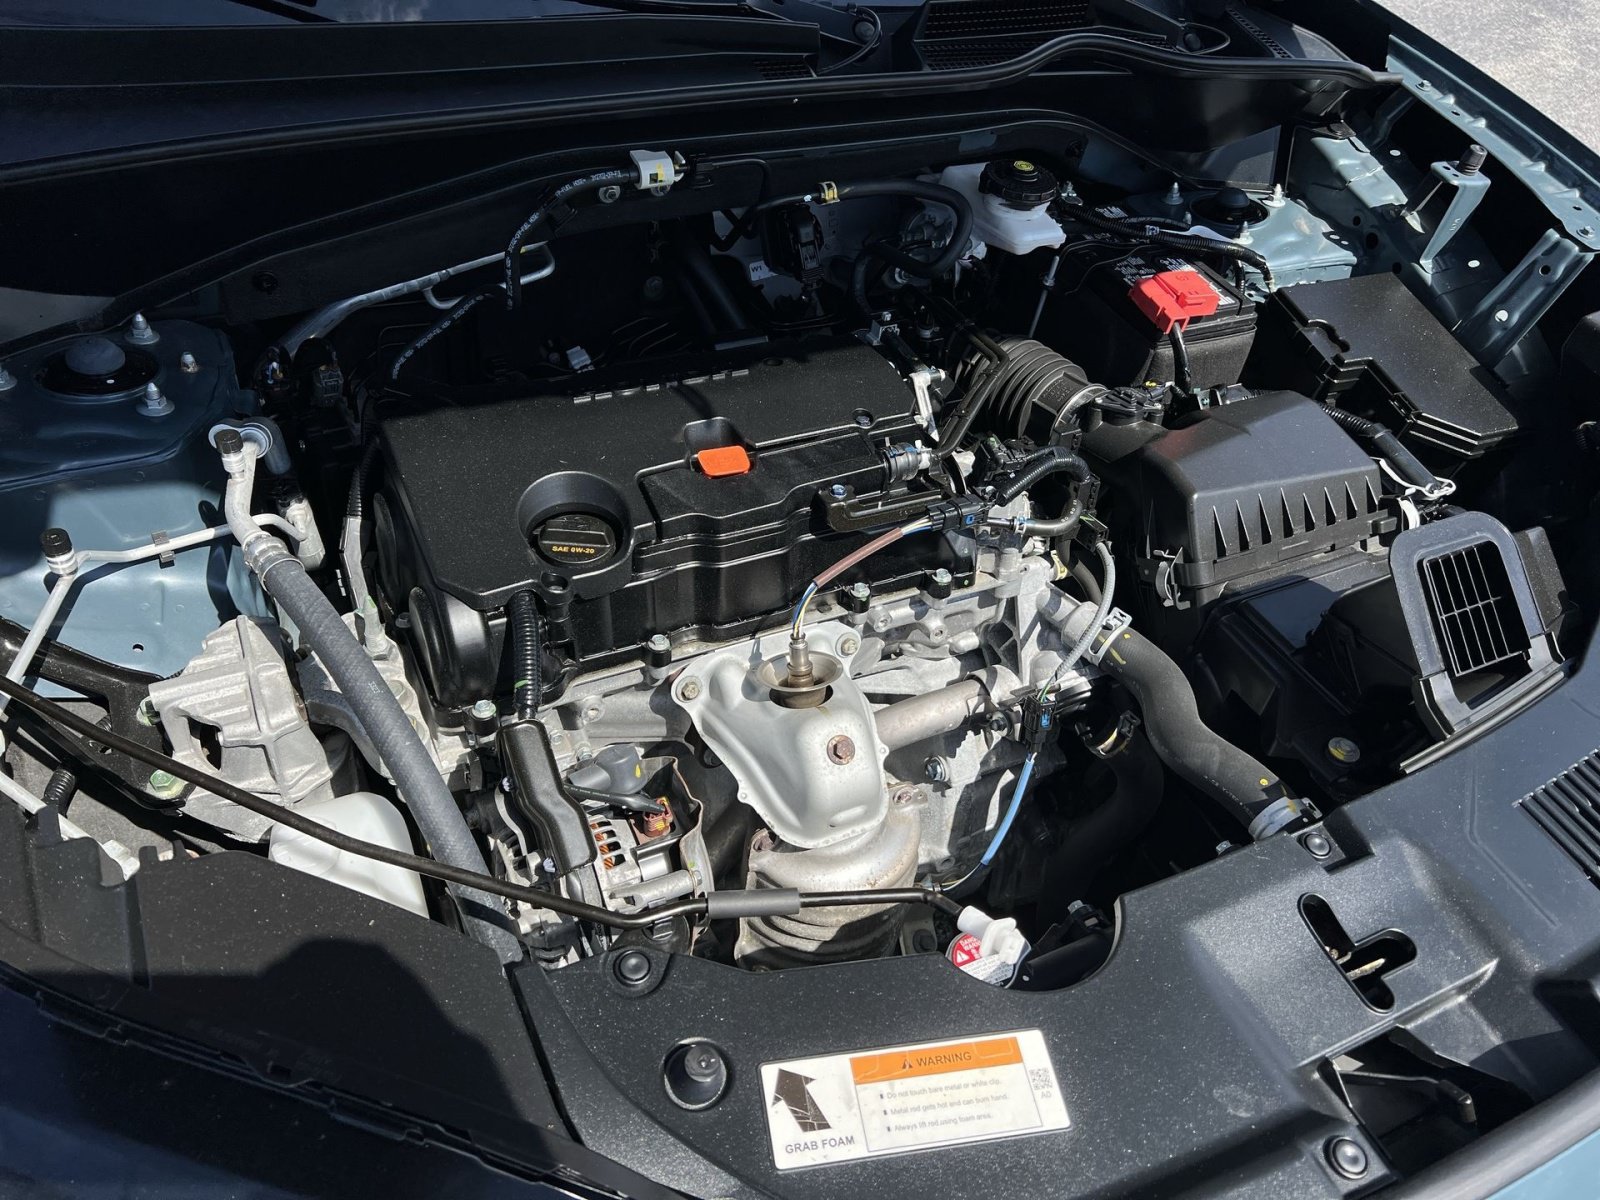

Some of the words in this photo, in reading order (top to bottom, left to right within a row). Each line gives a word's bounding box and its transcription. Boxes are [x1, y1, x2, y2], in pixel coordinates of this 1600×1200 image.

[916, 1051, 972, 1067] WARNING
[909, 1088, 927, 1096] touch
[928, 1086, 943, 1094] bare
[944, 1083, 962, 1091] metal
[890, 1107, 909, 1115] Metal
[922, 1104, 936, 1112] gets
[949, 1099, 961, 1107] and
[975, 1096, 990, 1104] burn
[894, 1123, 917, 1132] Always
[940, 1117, 958, 1125] using
[958, 1114, 975, 1122] foam
[785, 1141, 819, 1154] GRAB
[821, 1135, 855, 1149] FOAM
